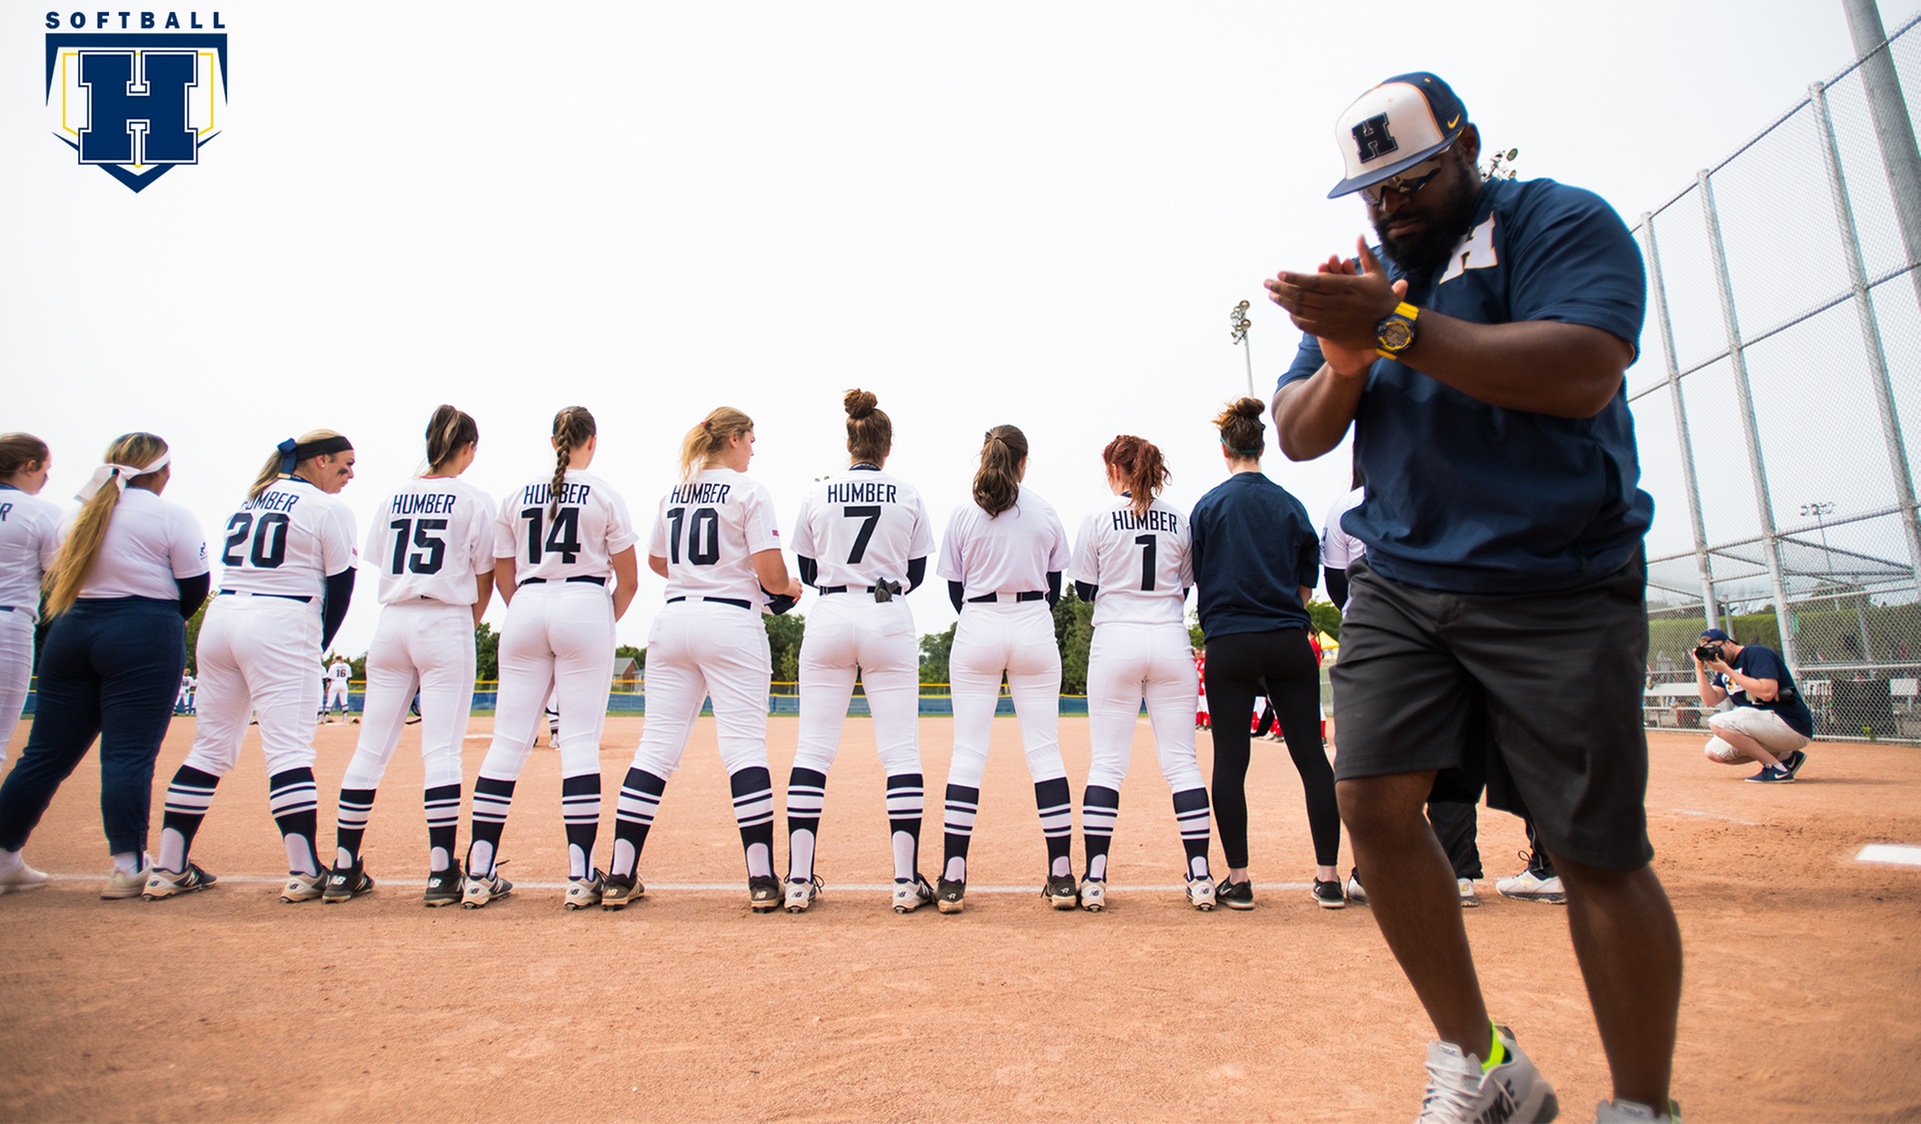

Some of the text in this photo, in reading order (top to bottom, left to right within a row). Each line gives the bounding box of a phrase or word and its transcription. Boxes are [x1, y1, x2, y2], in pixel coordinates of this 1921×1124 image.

[1351, 111, 1399, 164] H
[391, 493, 457, 514] HUMBER
[670, 483, 731, 504] HUMBER
[828, 482, 897, 504] HUMBER
[222, 512, 290, 569] 20
[390, 518, 448, 575] 15
[521, 507, 581, 564] 14
[667, 507, 720, 566] 10
[844, 505, 882, 565] 7
[1112, 510, 1177, 535] HUMBER
[1135, 534, 1156, 591] 1
